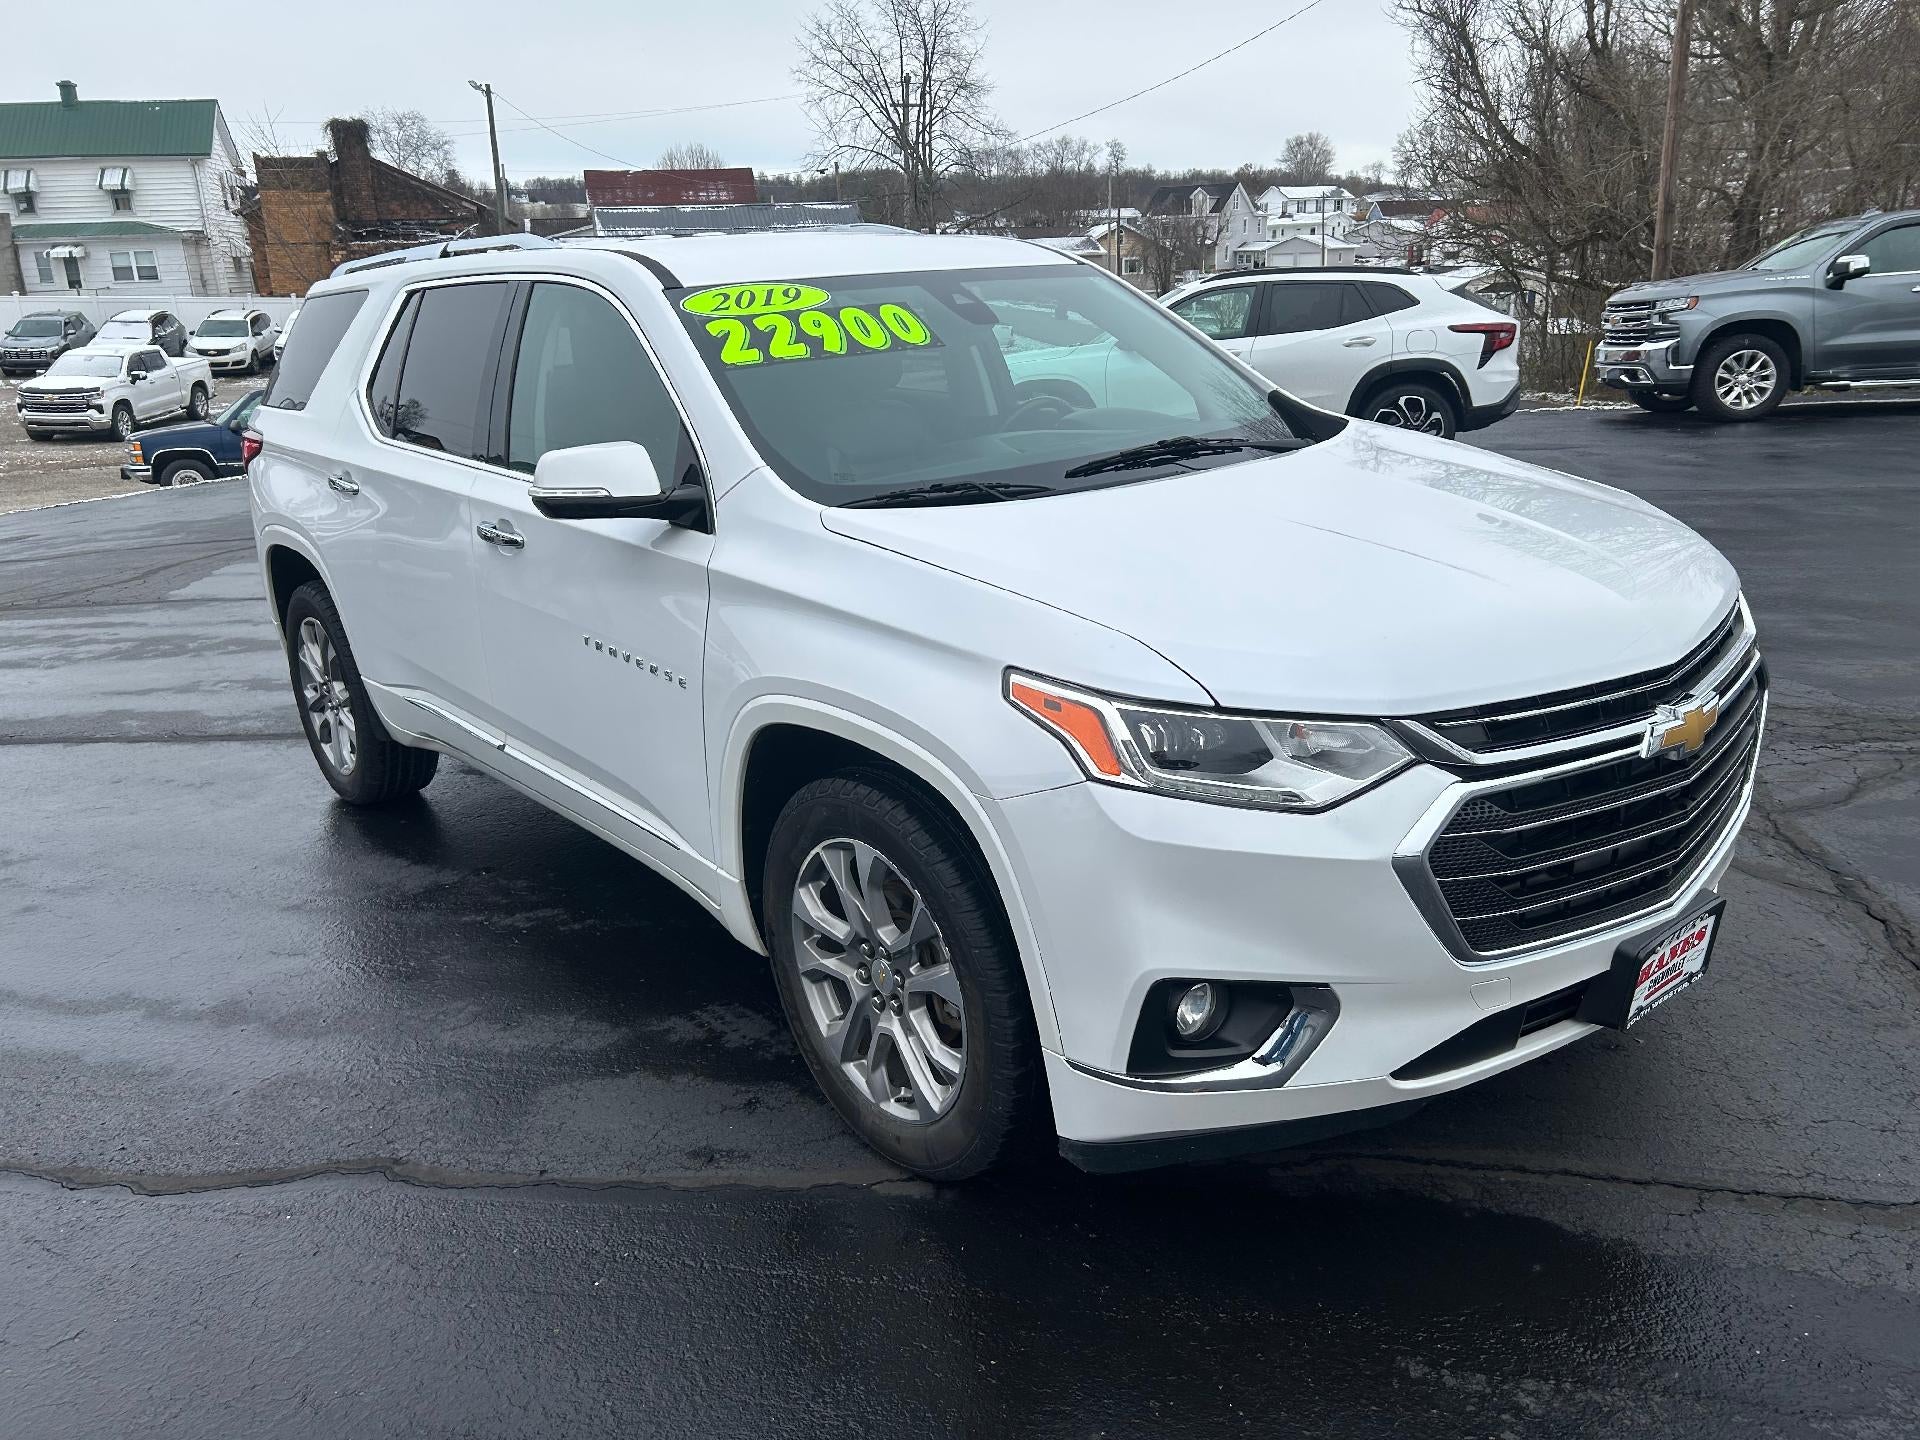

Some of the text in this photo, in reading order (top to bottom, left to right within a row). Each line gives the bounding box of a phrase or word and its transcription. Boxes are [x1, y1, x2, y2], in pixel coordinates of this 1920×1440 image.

[711, 286, 802, 312] 2019
[705, 304, 931, 365] 22900
[582, 634, 687, 689] TRAVERSE
[1647, 955, 1686, 991] CHEVROLET
[1626, 1006, 1651, 1030] SOUTH
